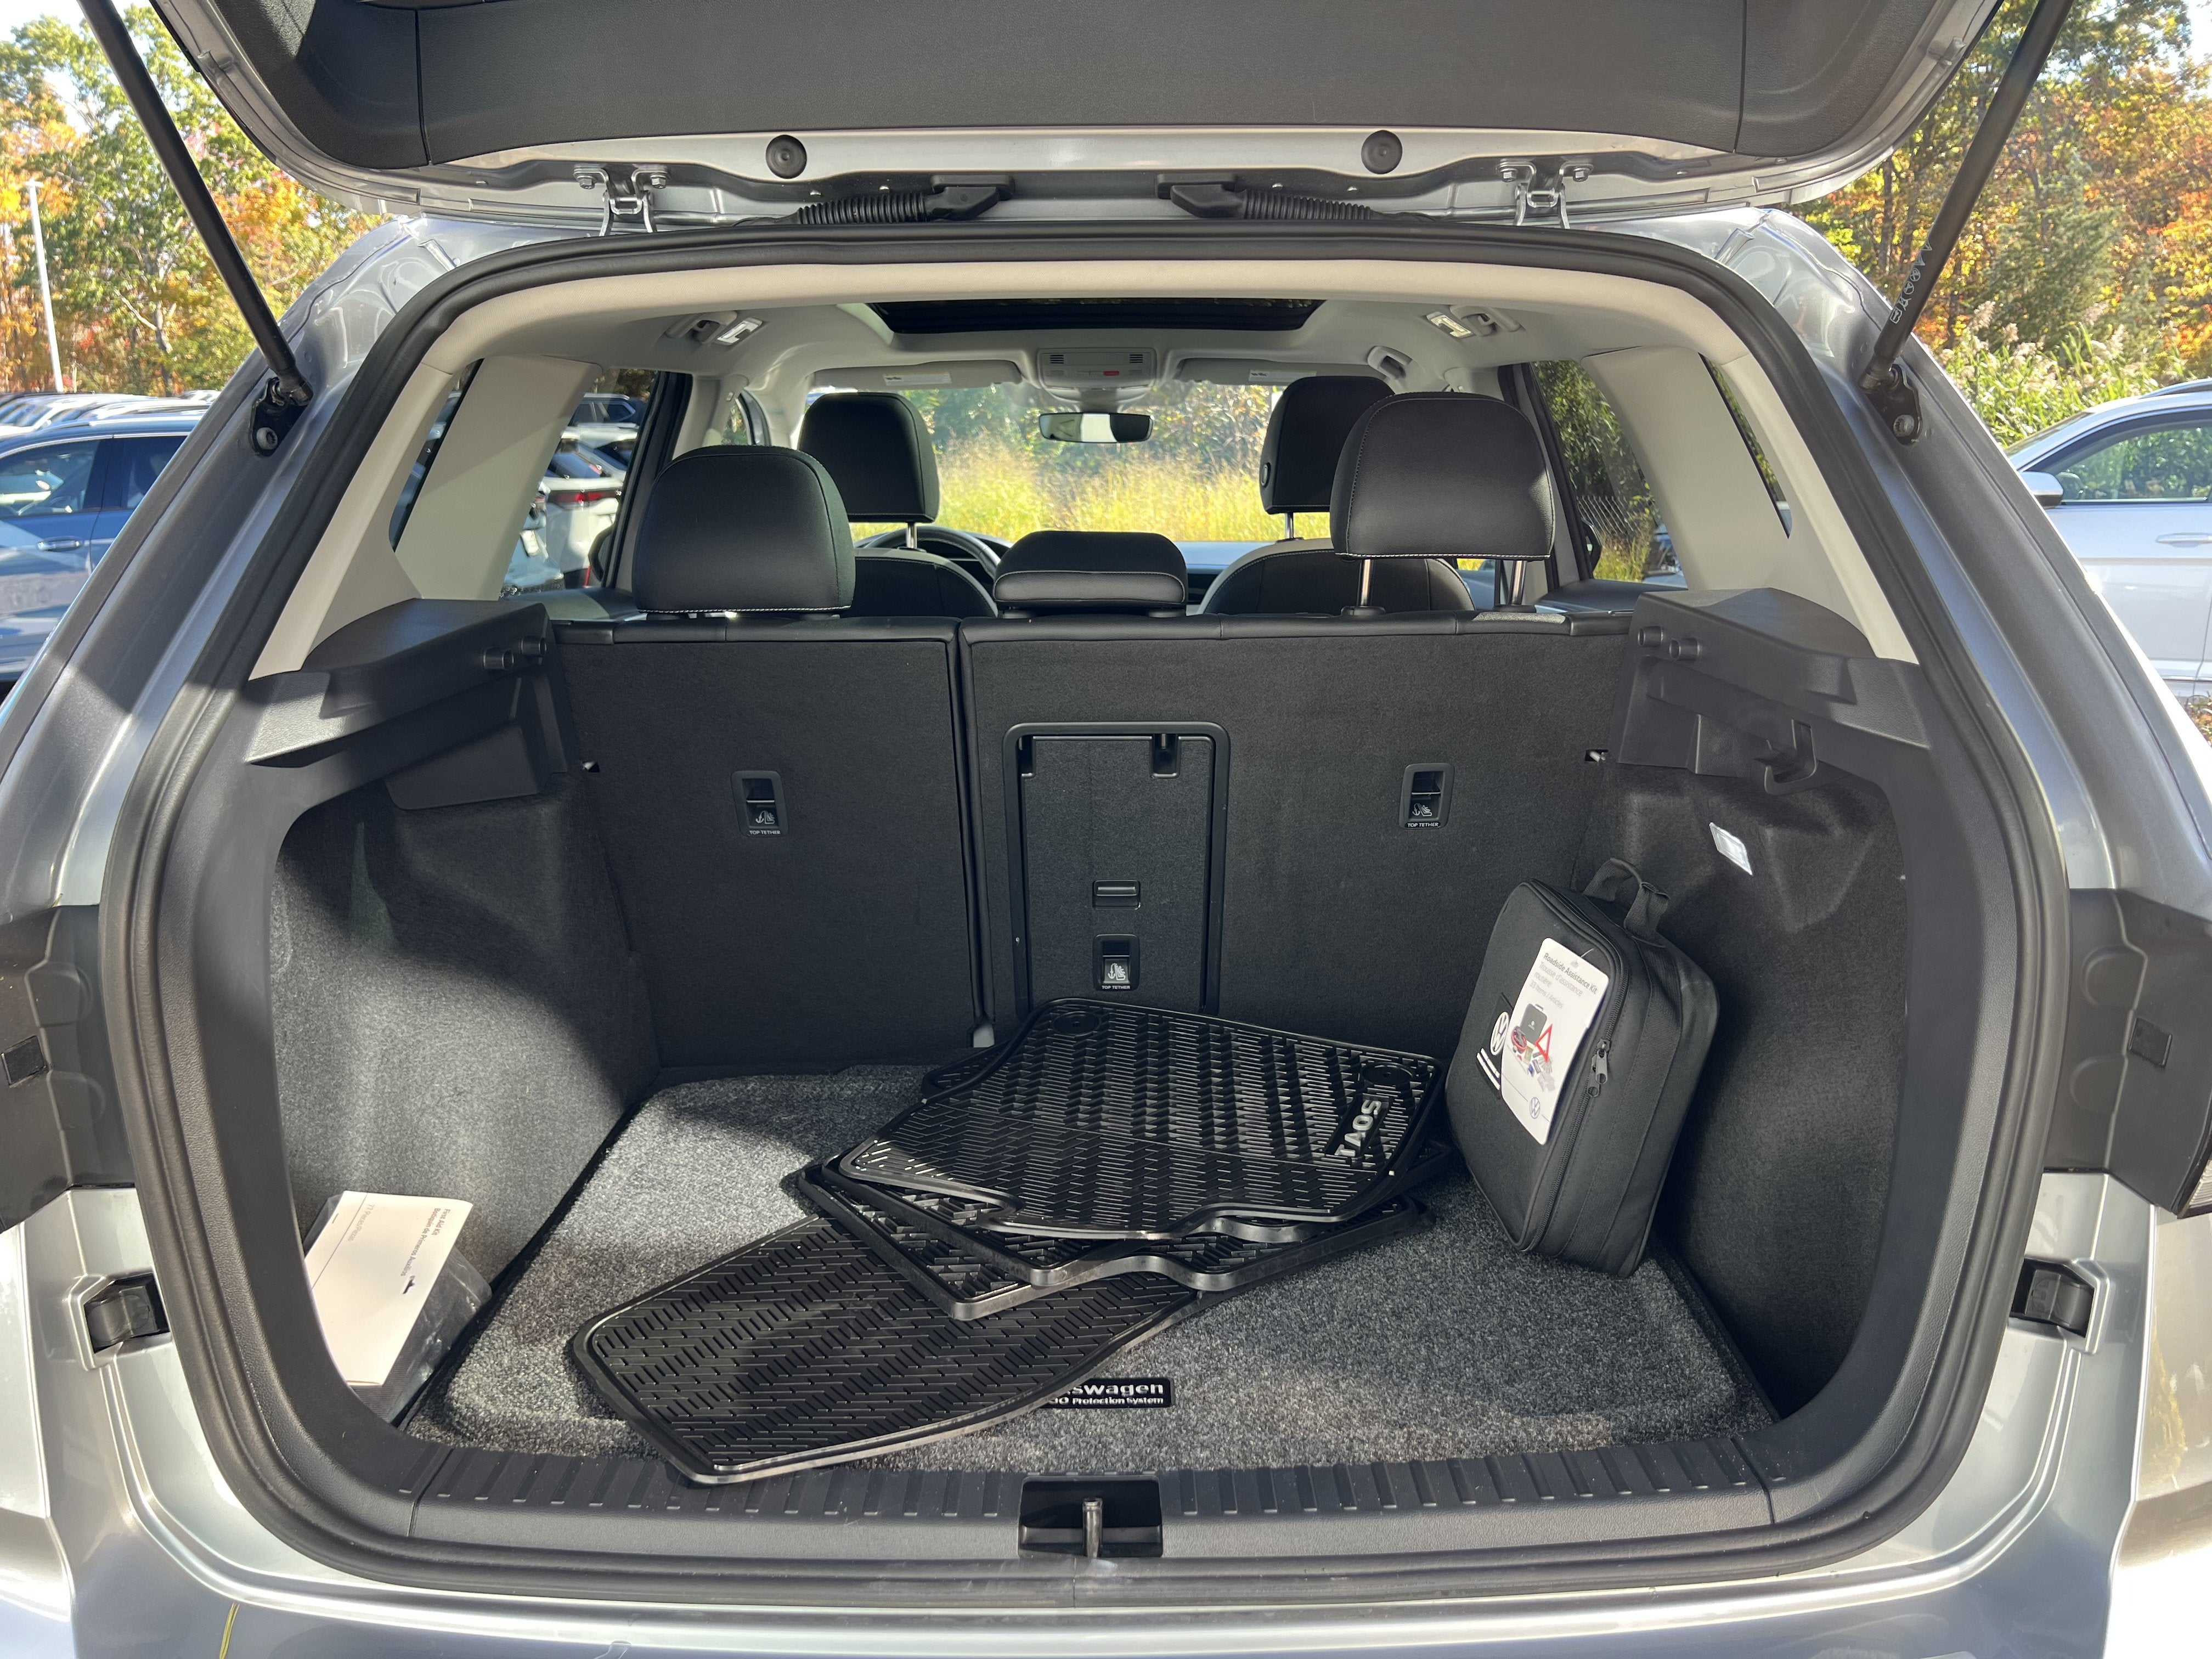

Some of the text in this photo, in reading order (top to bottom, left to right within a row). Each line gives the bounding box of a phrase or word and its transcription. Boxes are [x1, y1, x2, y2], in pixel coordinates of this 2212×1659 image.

[1539, 961, 1556, 978] Trousse
[1543, 952, 1599, 995] Roadside Assistance Kit
[1334, 1099, 1382, 1157] TAOS
[441, 1209, 451, 1219] First
[436, 1220, 445, 1228] Aid
[410, 1234, 427, 1256] Primeros
